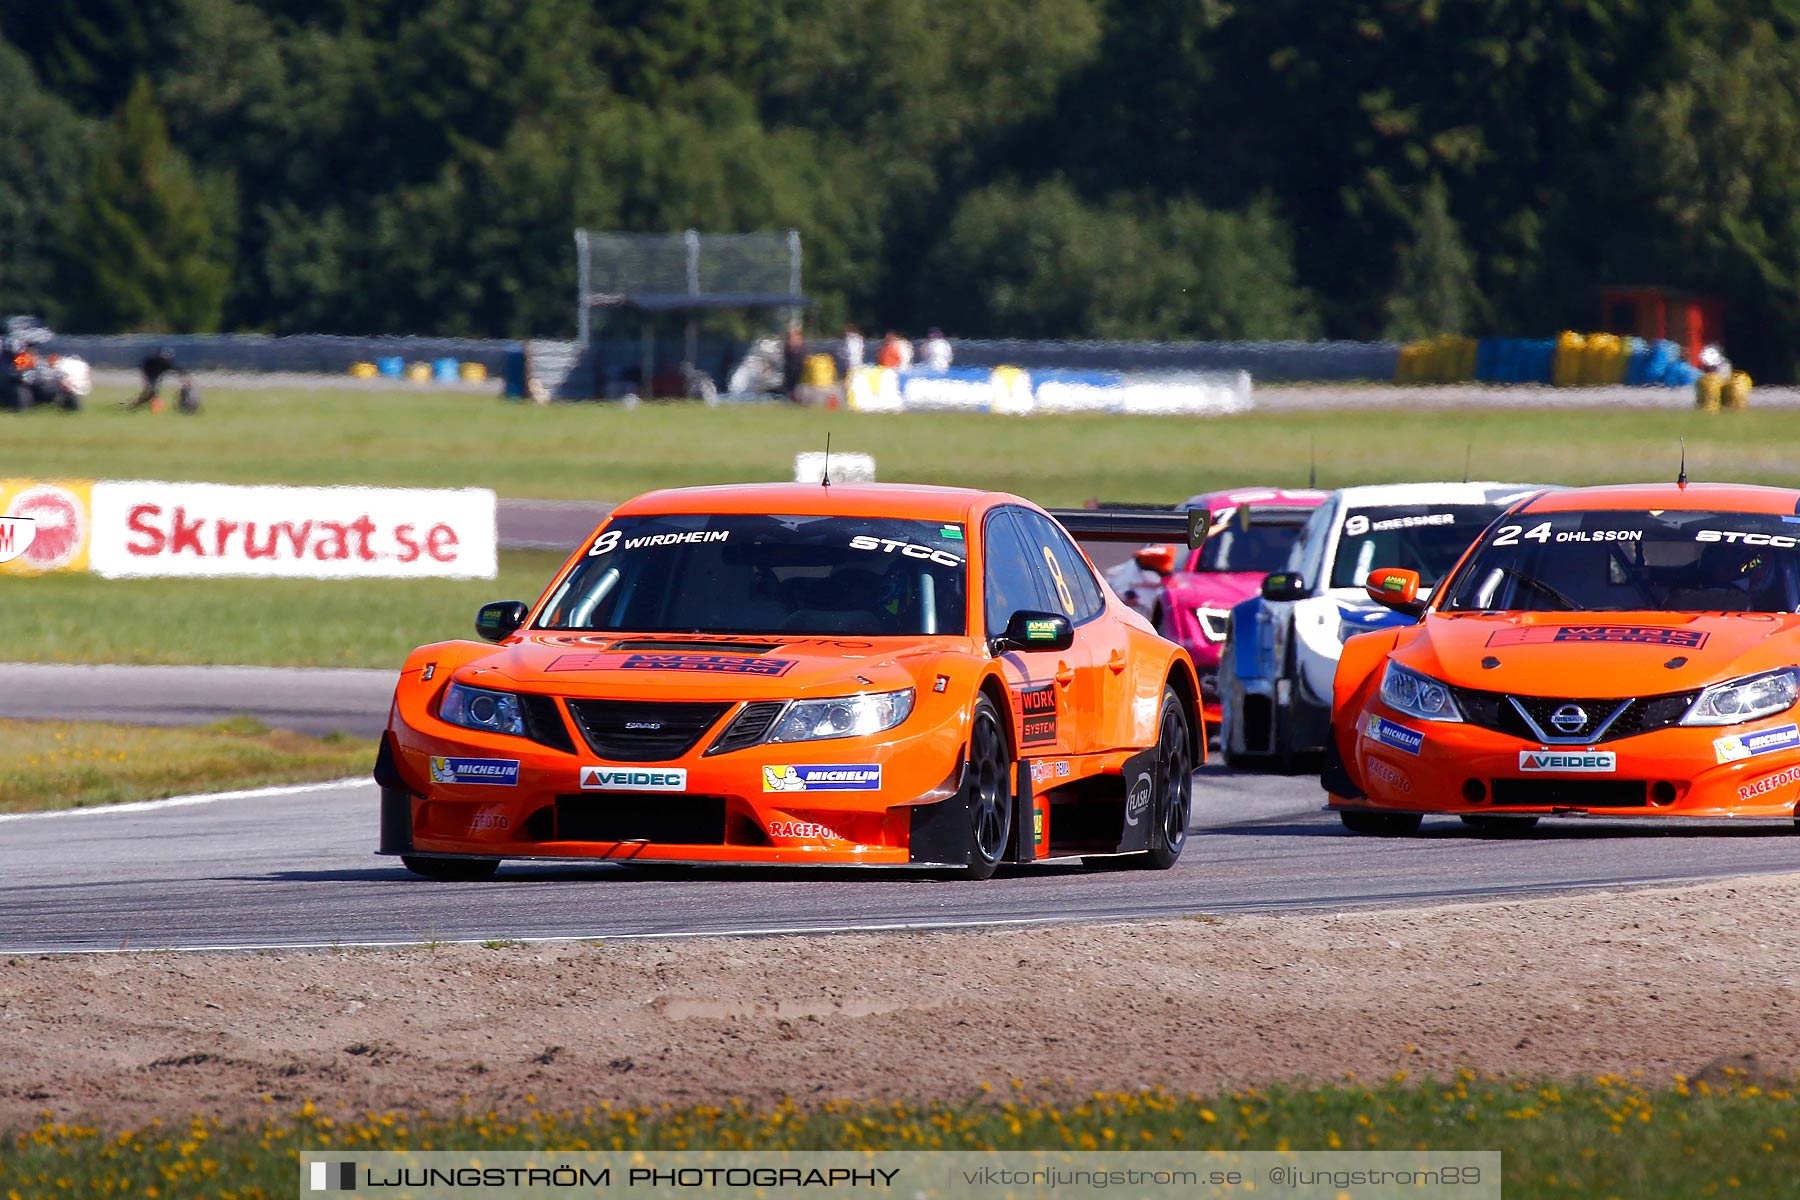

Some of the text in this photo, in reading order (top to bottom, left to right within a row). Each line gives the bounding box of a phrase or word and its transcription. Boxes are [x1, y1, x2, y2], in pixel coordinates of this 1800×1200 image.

[126, 503, 459, 562] Skruvat.se
[1346, 513, 1455, 536] 9 KRESSNER
[589, 530, 730, 557] 8 WIRDHEIM
[1492, 522, 1643, 547] 24 OHLSSON
[1695, 530, 1797, 549] STCC
[849, 535, 961, 567] STCC
[1043, 546, 1074, 616] 8
[1028, 621, 1056, 630] AMAB
[1567, 628, 1691, 637] WORK
[640, 655, 777, 666] WORK
[1023, 690, 1055, 709] WORK
[1025, 723, 1055, 736] SYSTEM
[1382, 726, 1421, 746] MICHELIN
[457, 765, 517, 776] MICHELIN
[1535, 757, 1611, 767] VEIDEC
[599, 772, 682, 786] VEIDEC
[806, 771, 880, 781] MICHELIN
[1738, 766, 1800, 800] RACEFOTO
[1129, 789, 1149, 811] FLASH
